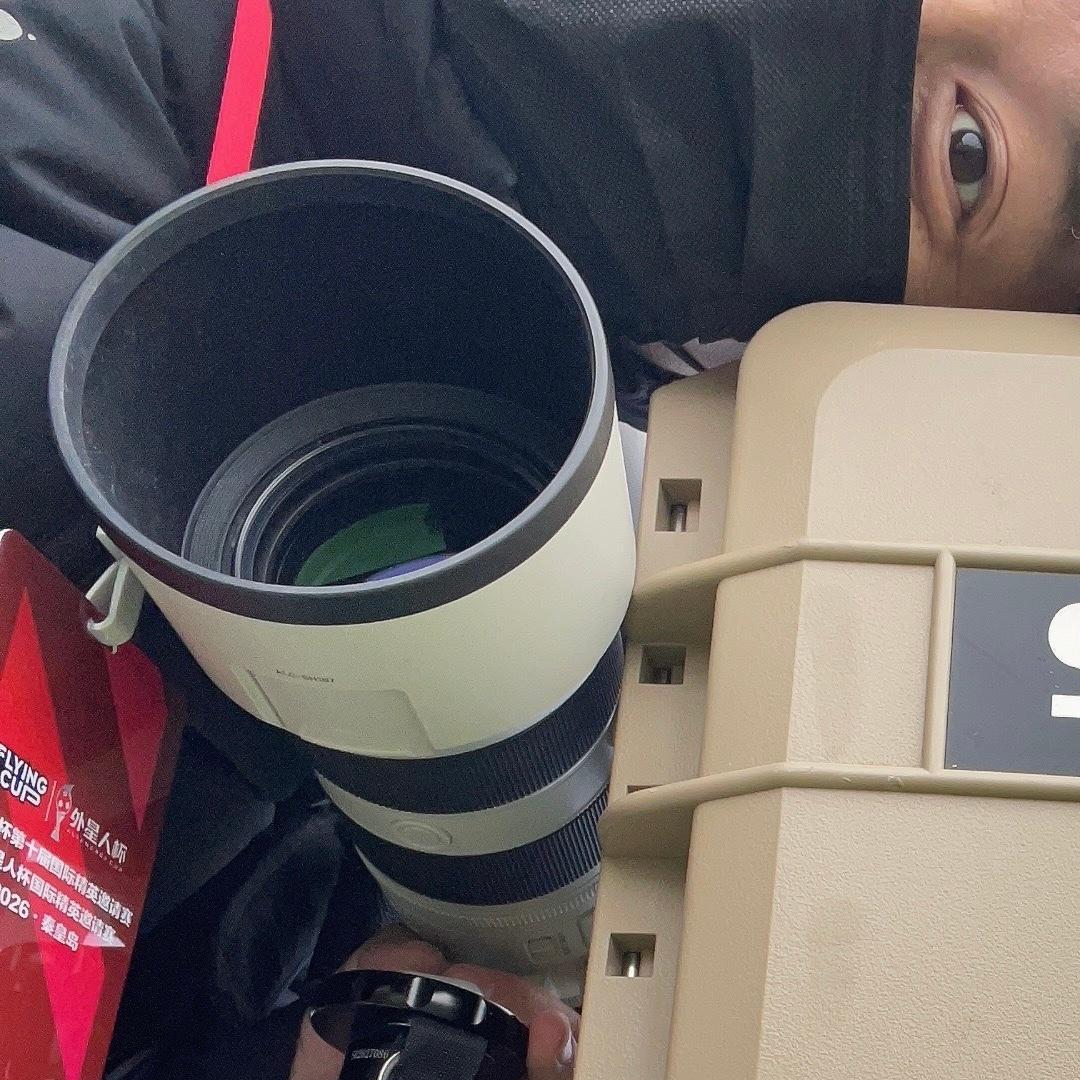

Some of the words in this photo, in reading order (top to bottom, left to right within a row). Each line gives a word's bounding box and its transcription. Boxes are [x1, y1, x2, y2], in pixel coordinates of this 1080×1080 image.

[0, 743, 48, 795] FLYING
[0, 769, 41, 806] CUP
[0, 884, 30, 919] 026
